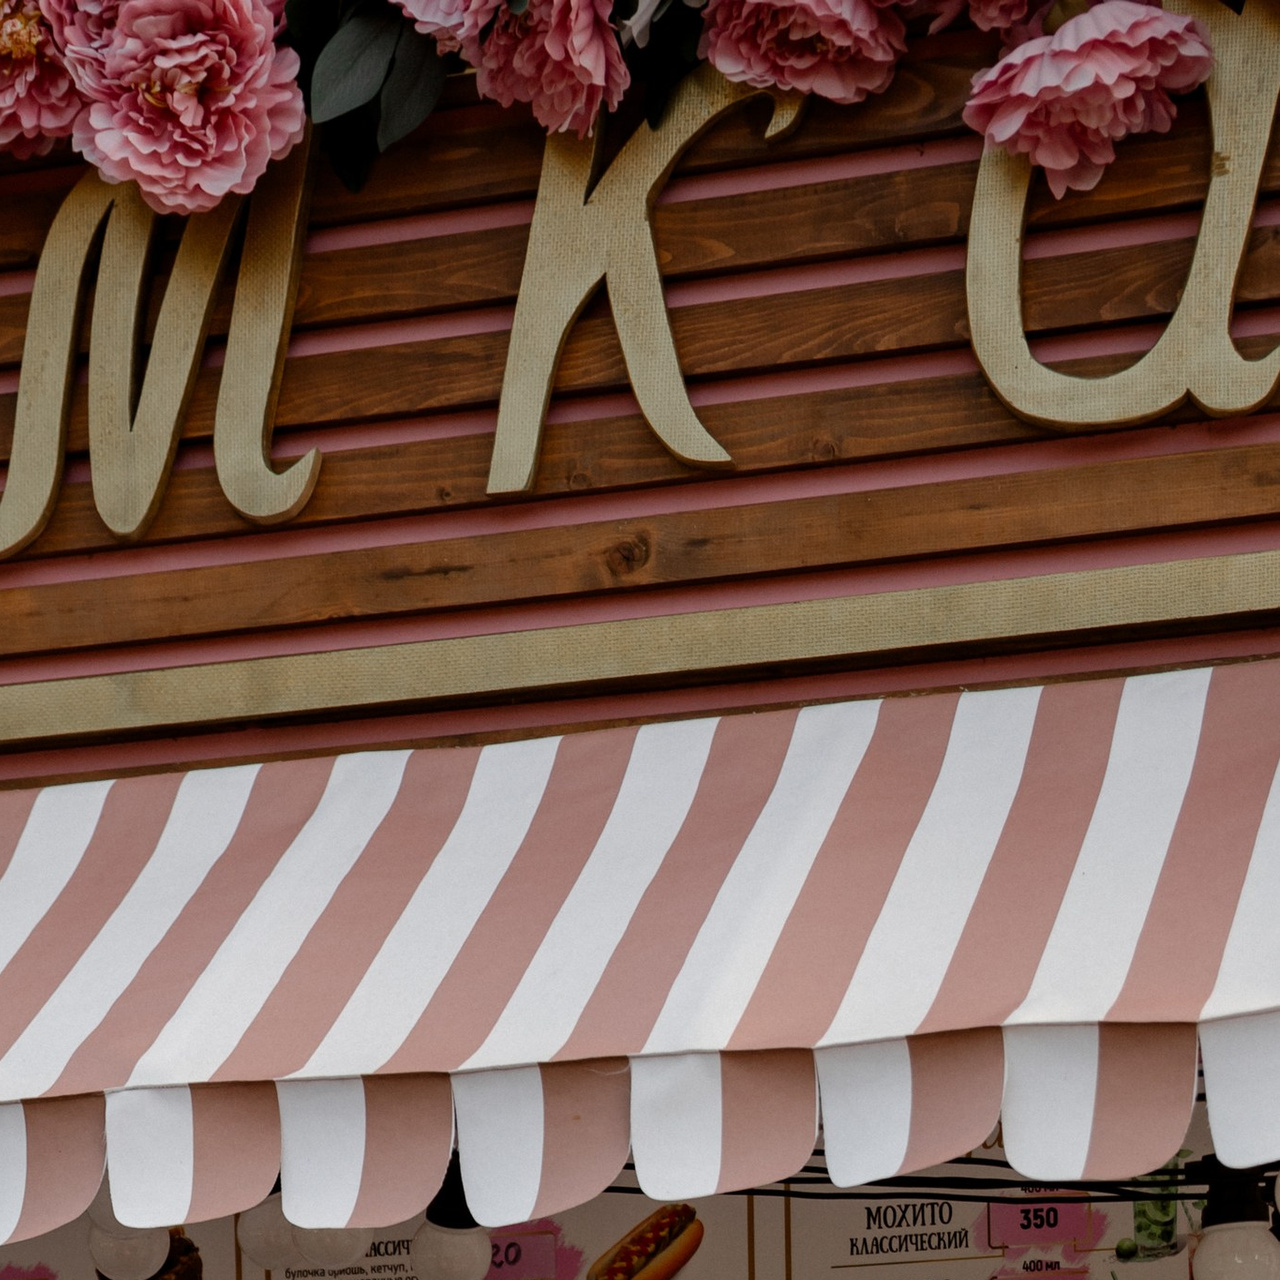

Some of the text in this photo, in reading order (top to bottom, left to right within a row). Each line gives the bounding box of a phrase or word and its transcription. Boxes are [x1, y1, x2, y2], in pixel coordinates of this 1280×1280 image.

[865, 1202, 952, 1230] МОХИТО
[1020, 1208, 1058, 1229] 350
[849, 1229, 969, 1256] КЛАССИЧЕСКИЙ
[285, 1267, 325, 1278] булочка
[371, 1264, 408, 1275] кетчуп,
[1022, 1260, 1060, 1272] 400 мл
